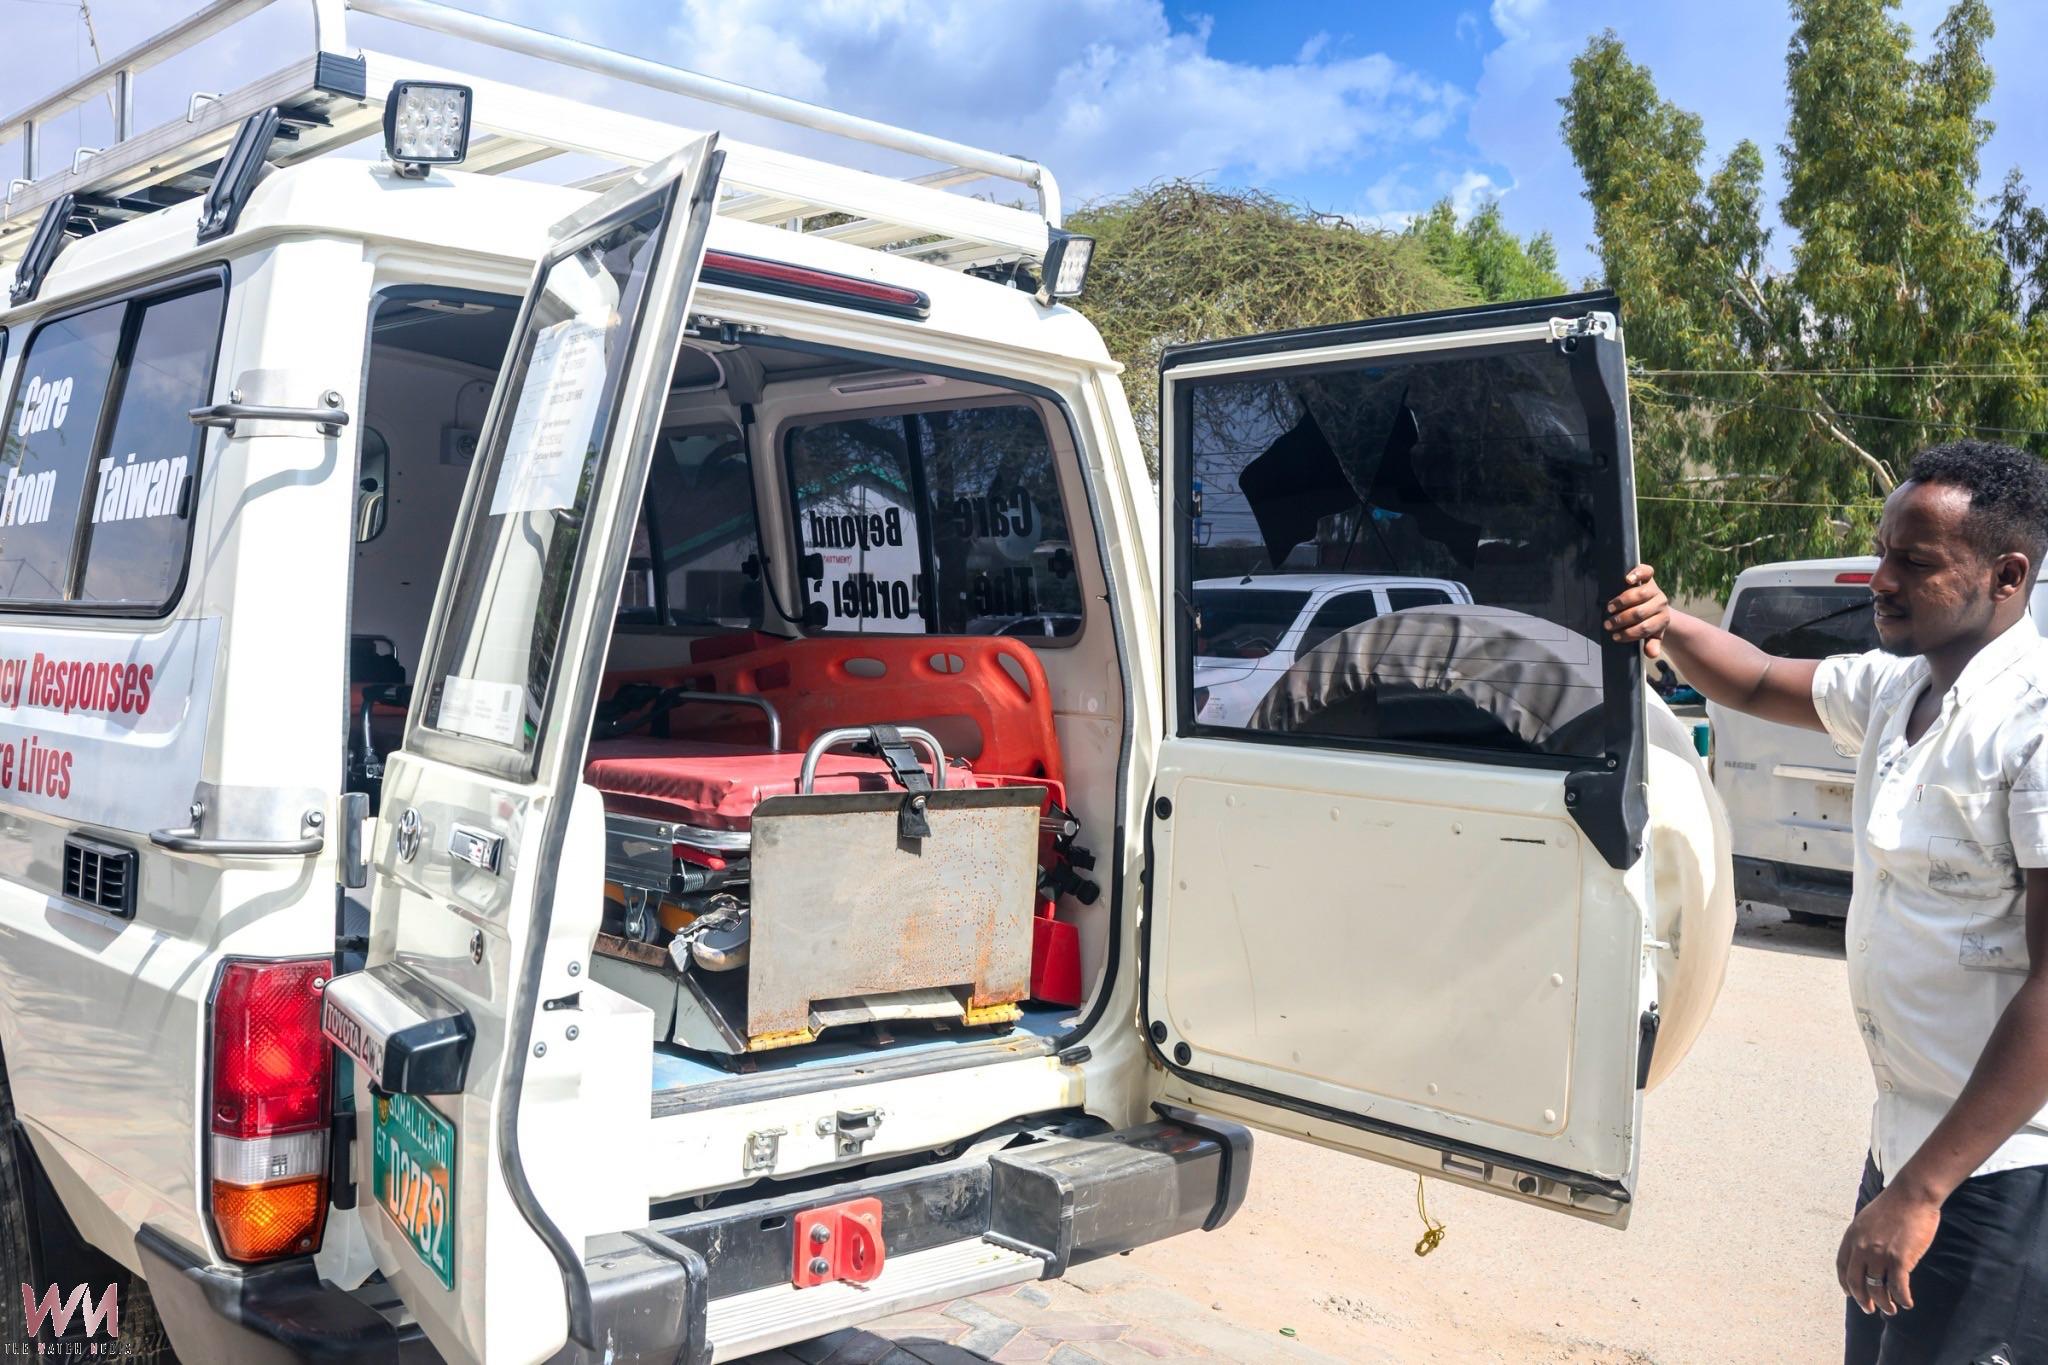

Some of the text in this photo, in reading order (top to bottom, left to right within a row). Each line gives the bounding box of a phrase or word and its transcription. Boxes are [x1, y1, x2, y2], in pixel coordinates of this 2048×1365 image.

[18, 376, 73, 436] Care
[0, 453, 188, 527] From Taiwan
[28, 652, 154, 715] Responses
[18, 736, 73, 799] Lives
[327, 1003, 361, 1057] TOYOTA
[389, 1094, 447, 1168] SOMALILAND
[376, 1126, 445, 1271] GT D2732
